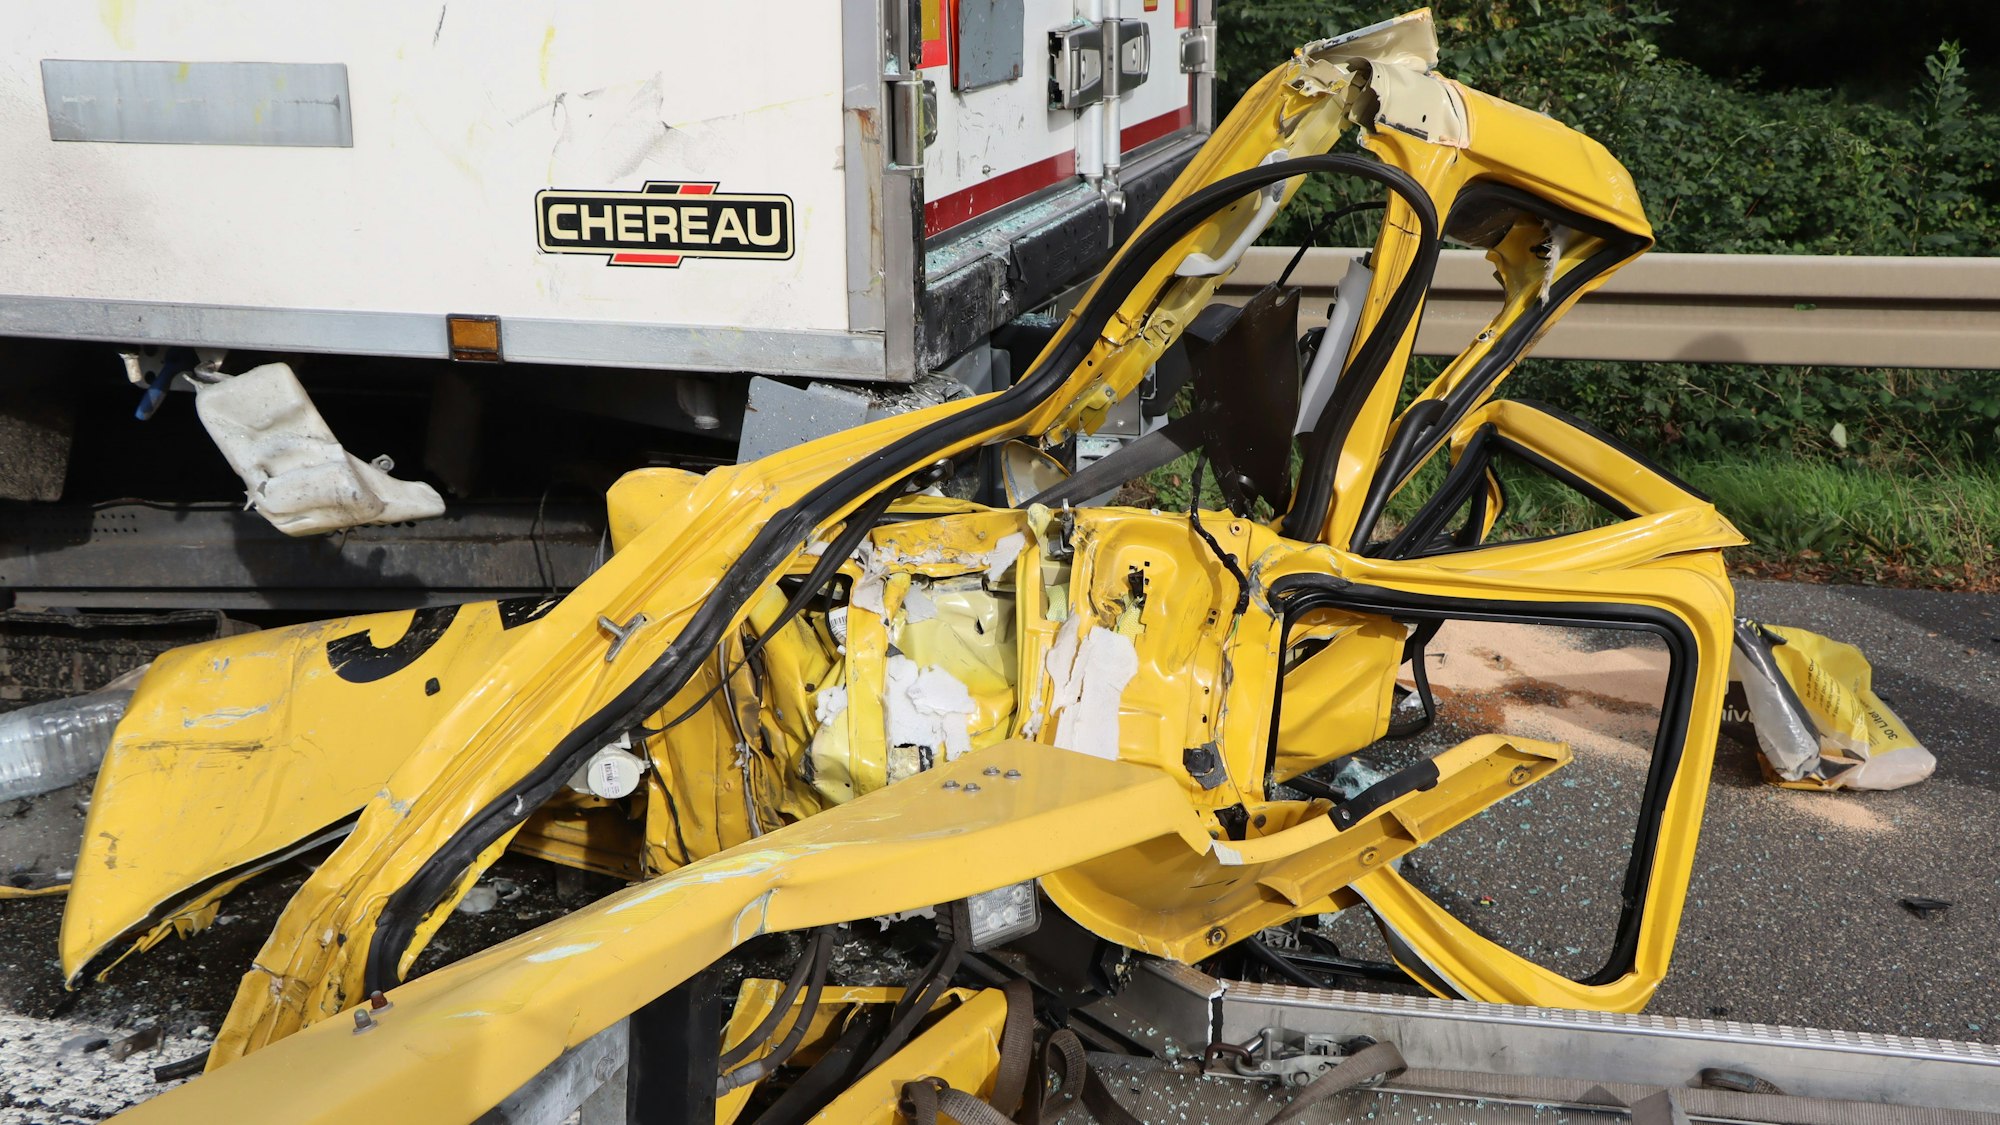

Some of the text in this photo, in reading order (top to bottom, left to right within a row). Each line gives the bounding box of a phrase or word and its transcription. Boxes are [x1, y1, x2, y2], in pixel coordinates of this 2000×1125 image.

[548, 203, 781, 246] CHEREAU
[1868, 711, 1888, 729] Liter
[1884, 728, 1898, 741] 30
